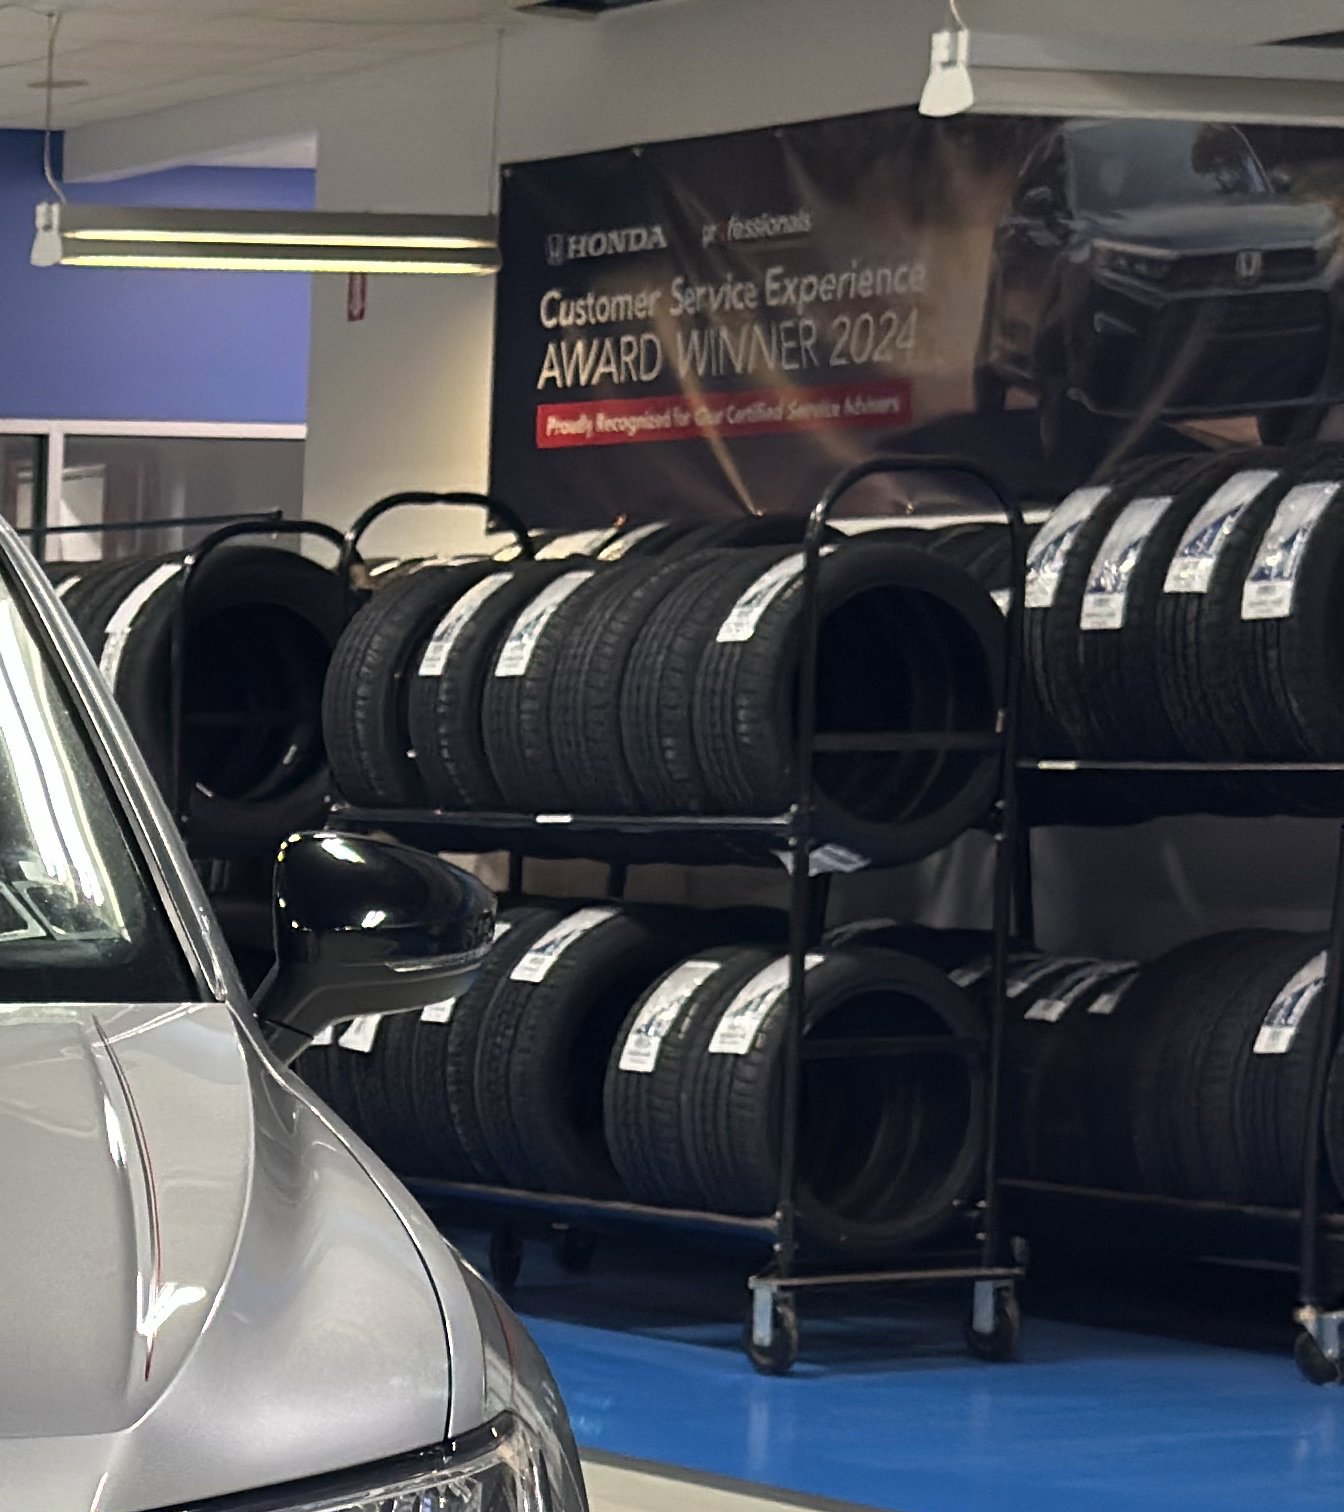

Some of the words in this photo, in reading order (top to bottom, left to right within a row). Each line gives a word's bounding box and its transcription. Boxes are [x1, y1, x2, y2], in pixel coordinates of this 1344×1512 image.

[566, 225, 668, 260] HONDA
[539, 288, 661, 329] Customer
[669, 271, 758, 317] Service
[765, 259, 927, 316] Experience
[536, 332, 662, 390] AWARD
[675, 319, 820, 379] WINNER
[828, 308, 919, 368] 2024
[546, 414, 593, 438] Proudly
[595, 408, 672, 437] Recognized
